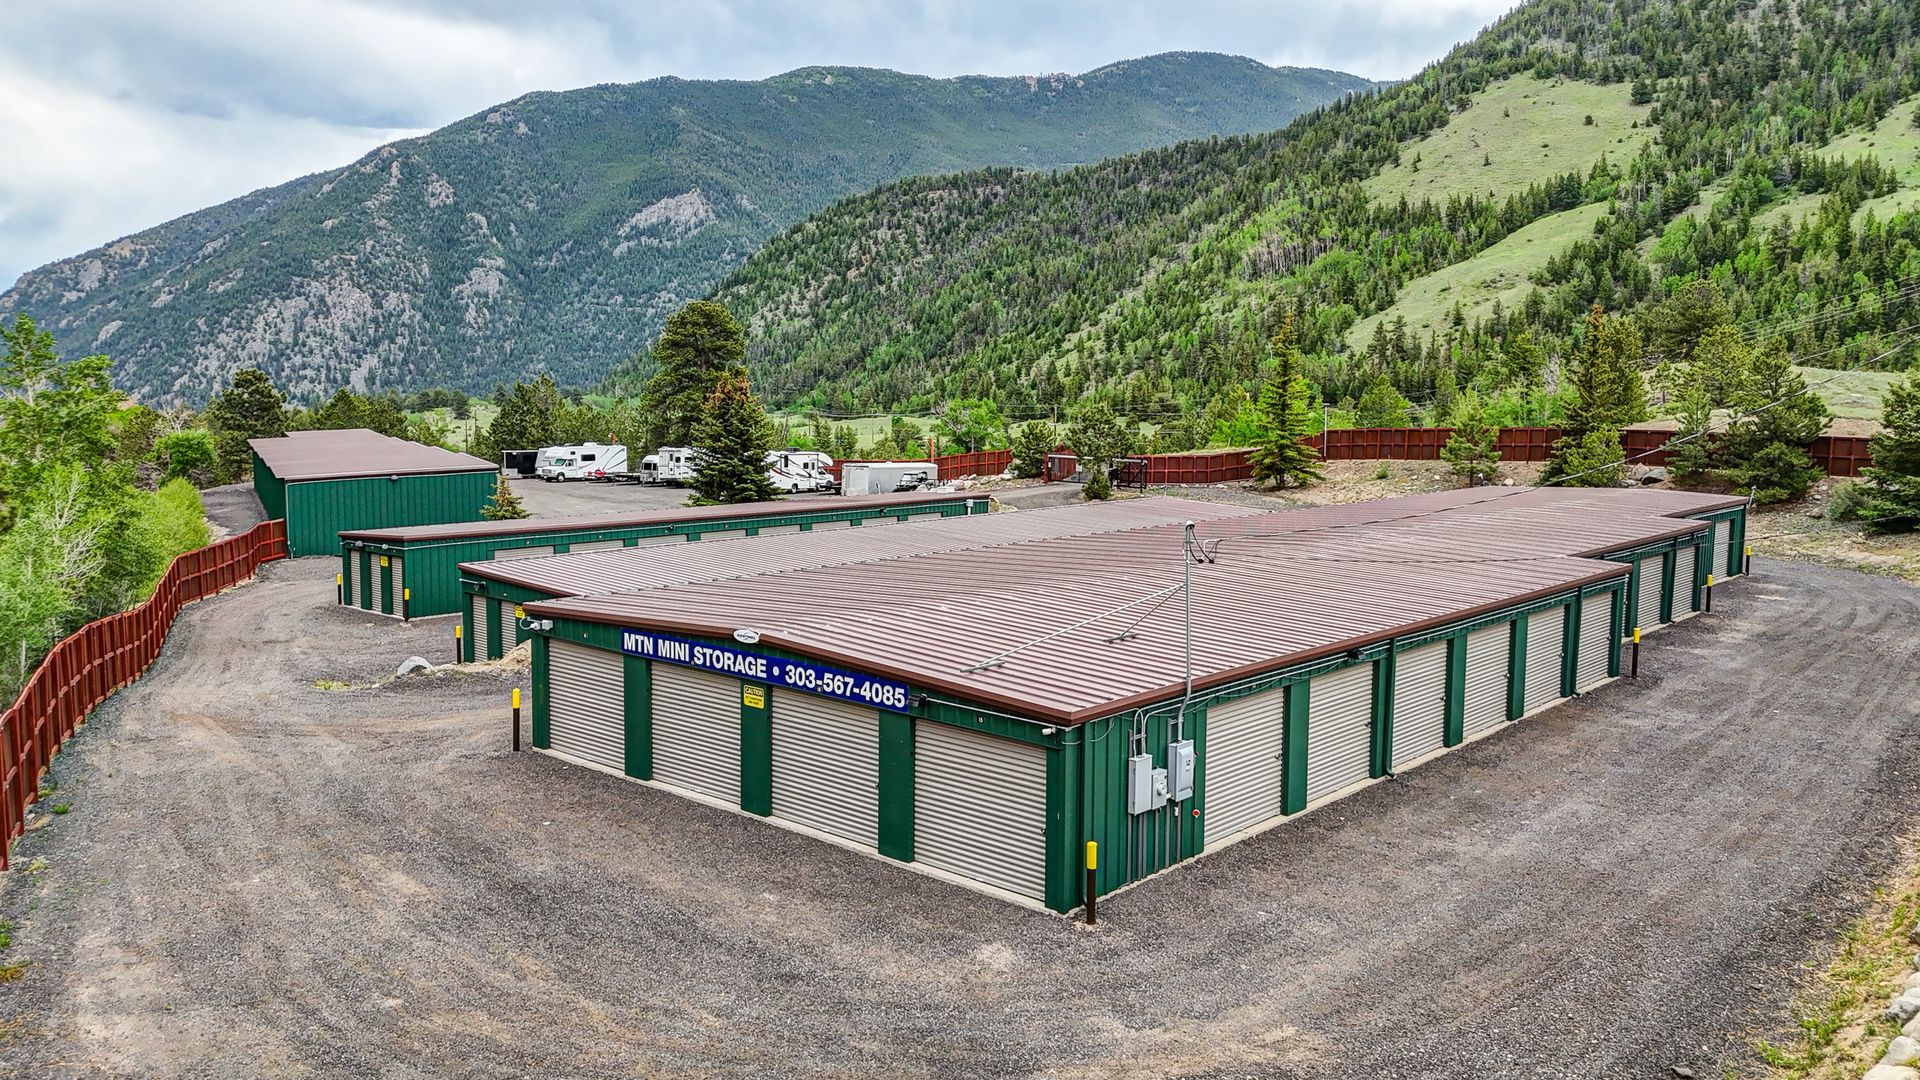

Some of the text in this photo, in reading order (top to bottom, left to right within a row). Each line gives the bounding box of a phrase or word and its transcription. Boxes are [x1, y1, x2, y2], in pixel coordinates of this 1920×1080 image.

[623, 632, 905, 708] MTN MINI STORAGE 303-567-4085
[745, 686, 763, 697] CAUTION
